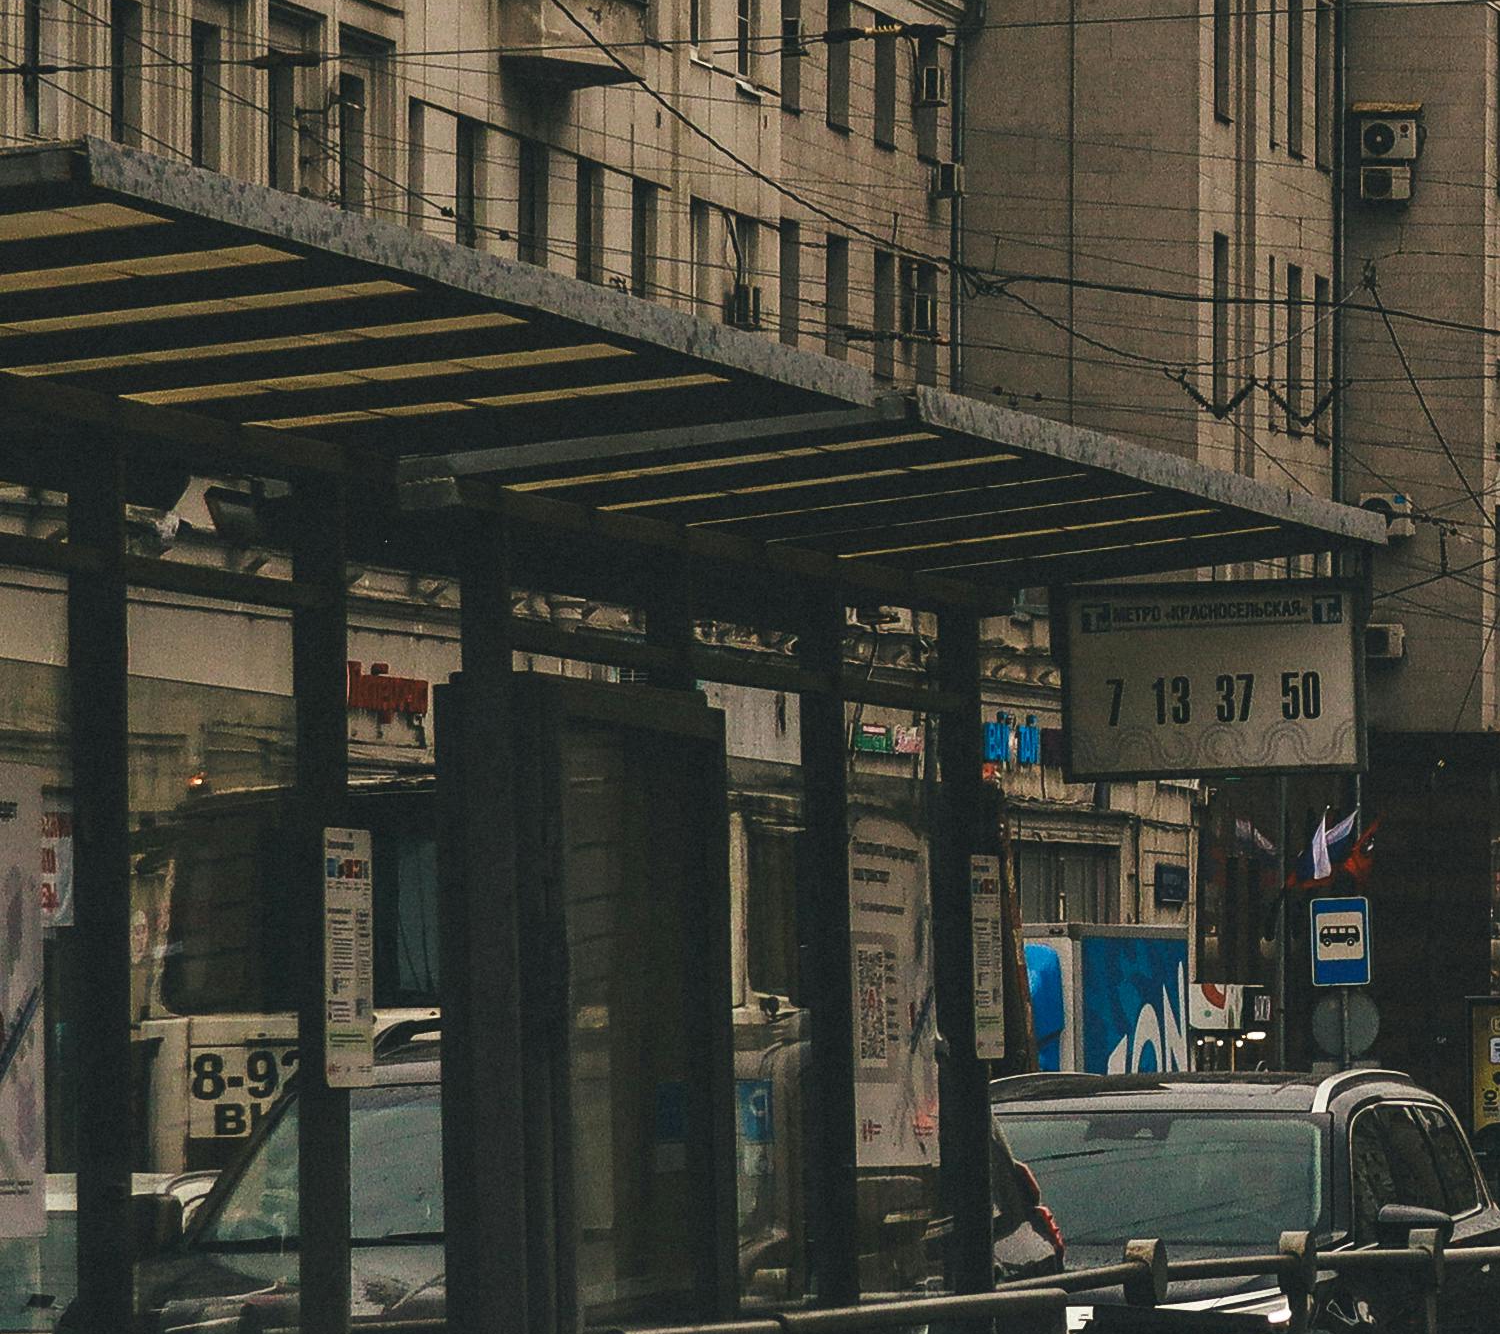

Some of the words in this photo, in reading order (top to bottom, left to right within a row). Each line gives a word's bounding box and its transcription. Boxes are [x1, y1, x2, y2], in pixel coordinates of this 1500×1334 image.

[1112, 604, 1162, 623] МЕТРО
[1166, 599, 1308, 622] «КРАСНОСЕЛЬСКАЯ»
[1106, 678, 1124, 727] 7
[1152, 675, 1191, 725] 13
[1216, 673, 1255, 723] 37
[1281, 670, 1321, 720] 50
